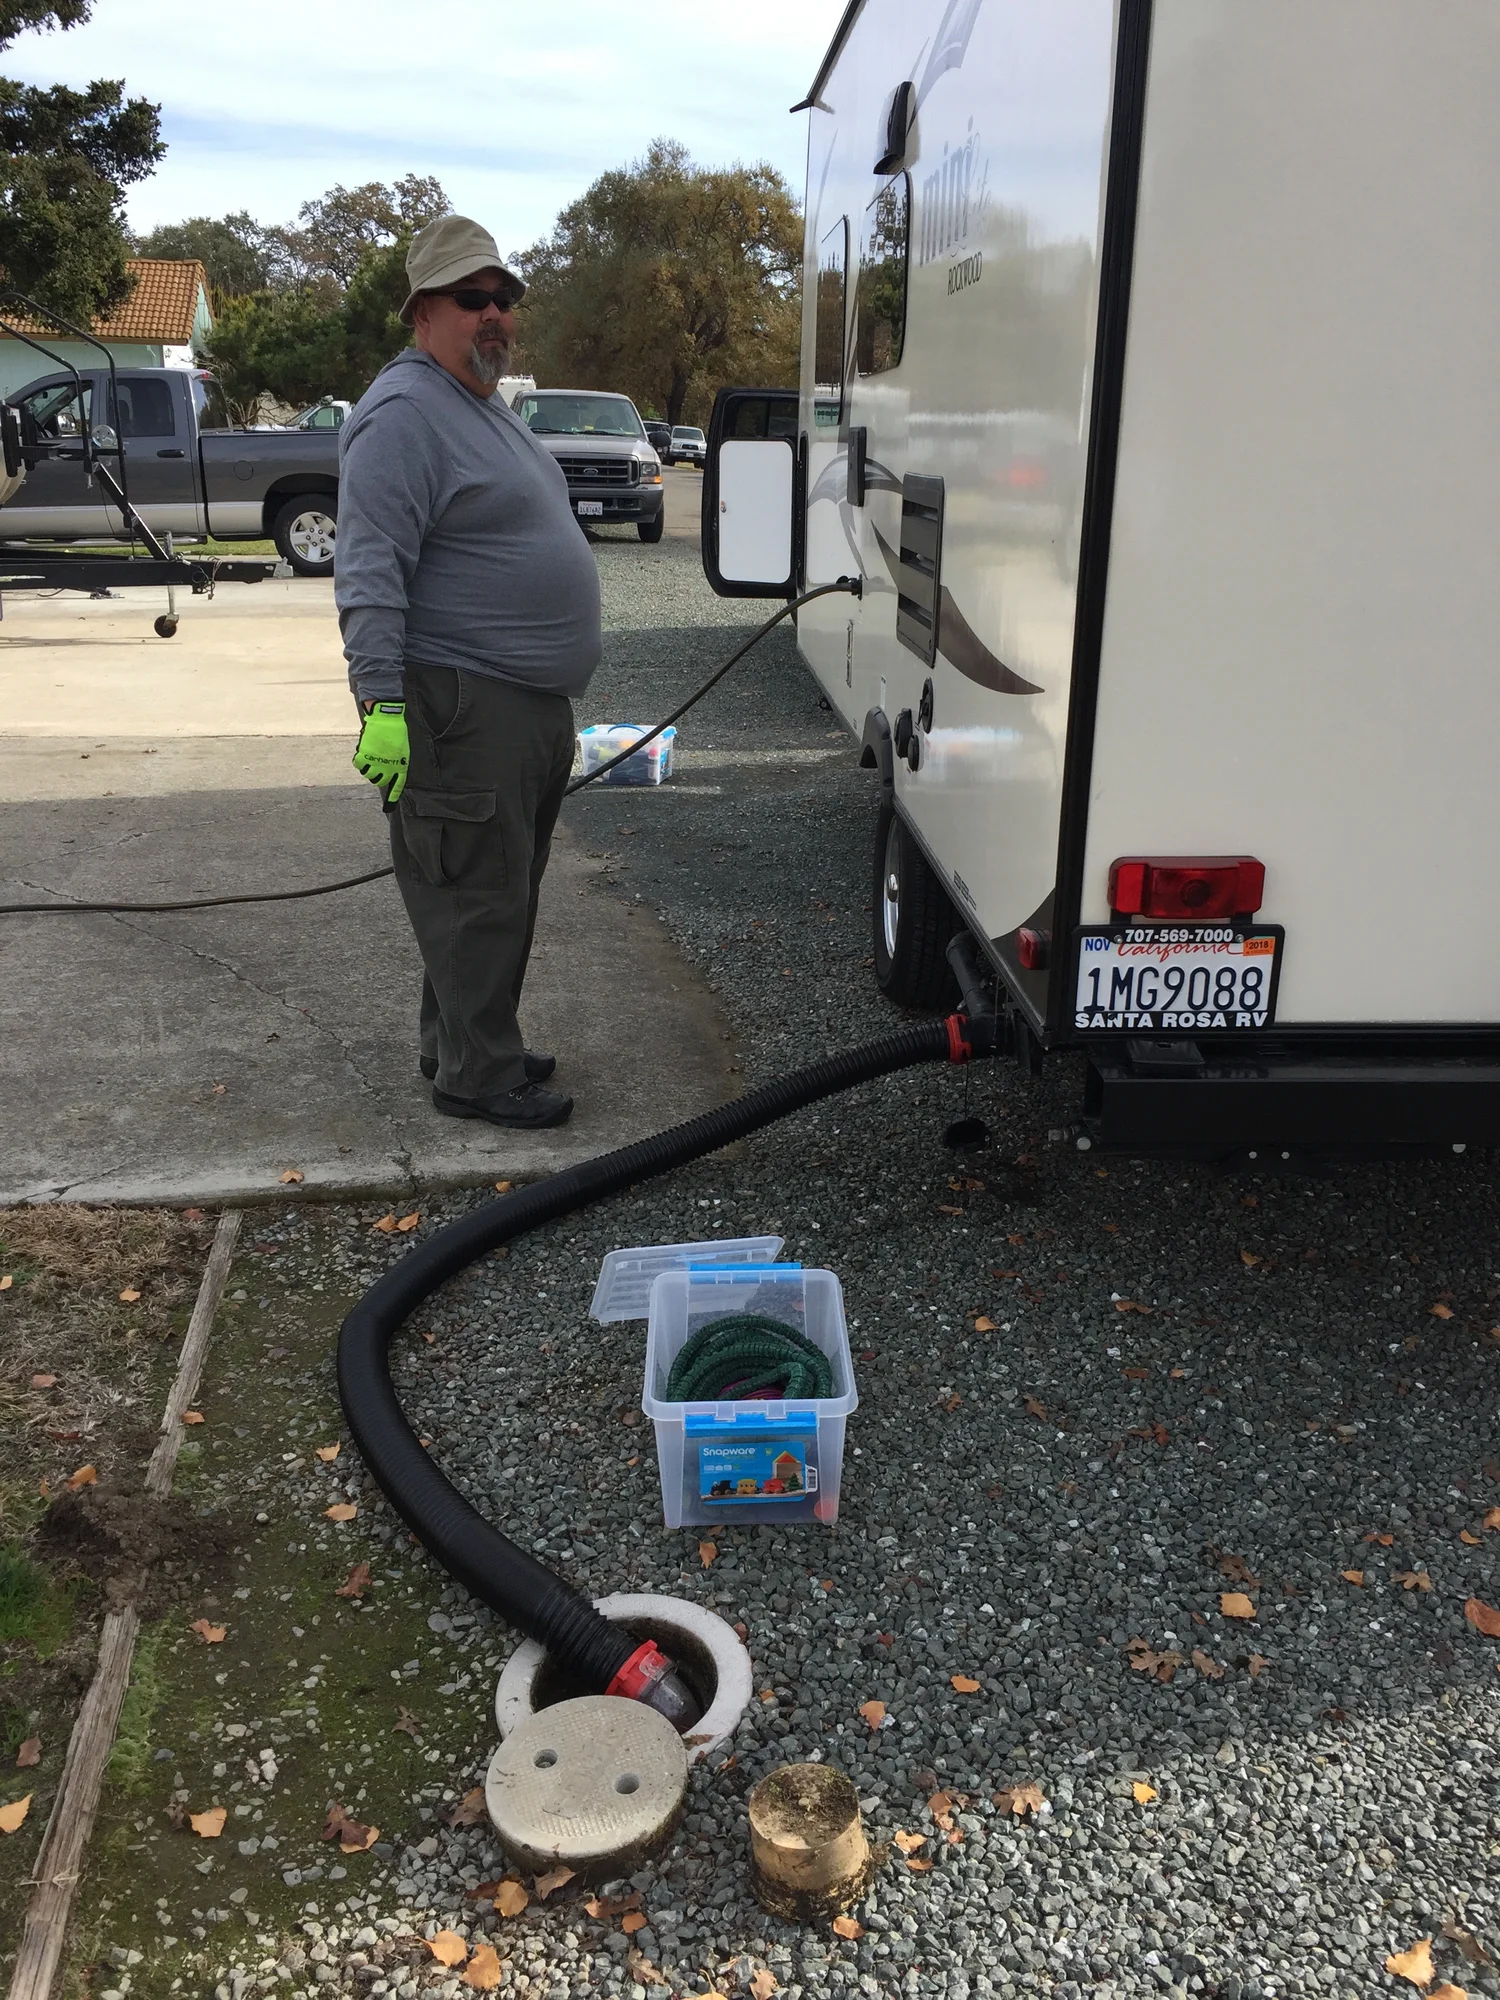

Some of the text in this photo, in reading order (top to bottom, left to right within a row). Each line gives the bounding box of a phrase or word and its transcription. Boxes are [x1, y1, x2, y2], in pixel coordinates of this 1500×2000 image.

[919, 115, 974, 268] mini
[947, 251, 983, 296] ROCKWOOD
[364, 754, 400, 765] carhartt
[1124, 929, 1234, 943] 707-569-7000
[1085, 938, 1111, 951] NOV
[1248, 940, 1269, 950] 2018
[1117, 942, 1244, 963] California
[1083, 966, 1264, 1012] 1MG9088
[1075, 1011, 1269, 1028] SANTA ROSA RV
[703, 1447, 755, 1457] Snapware
